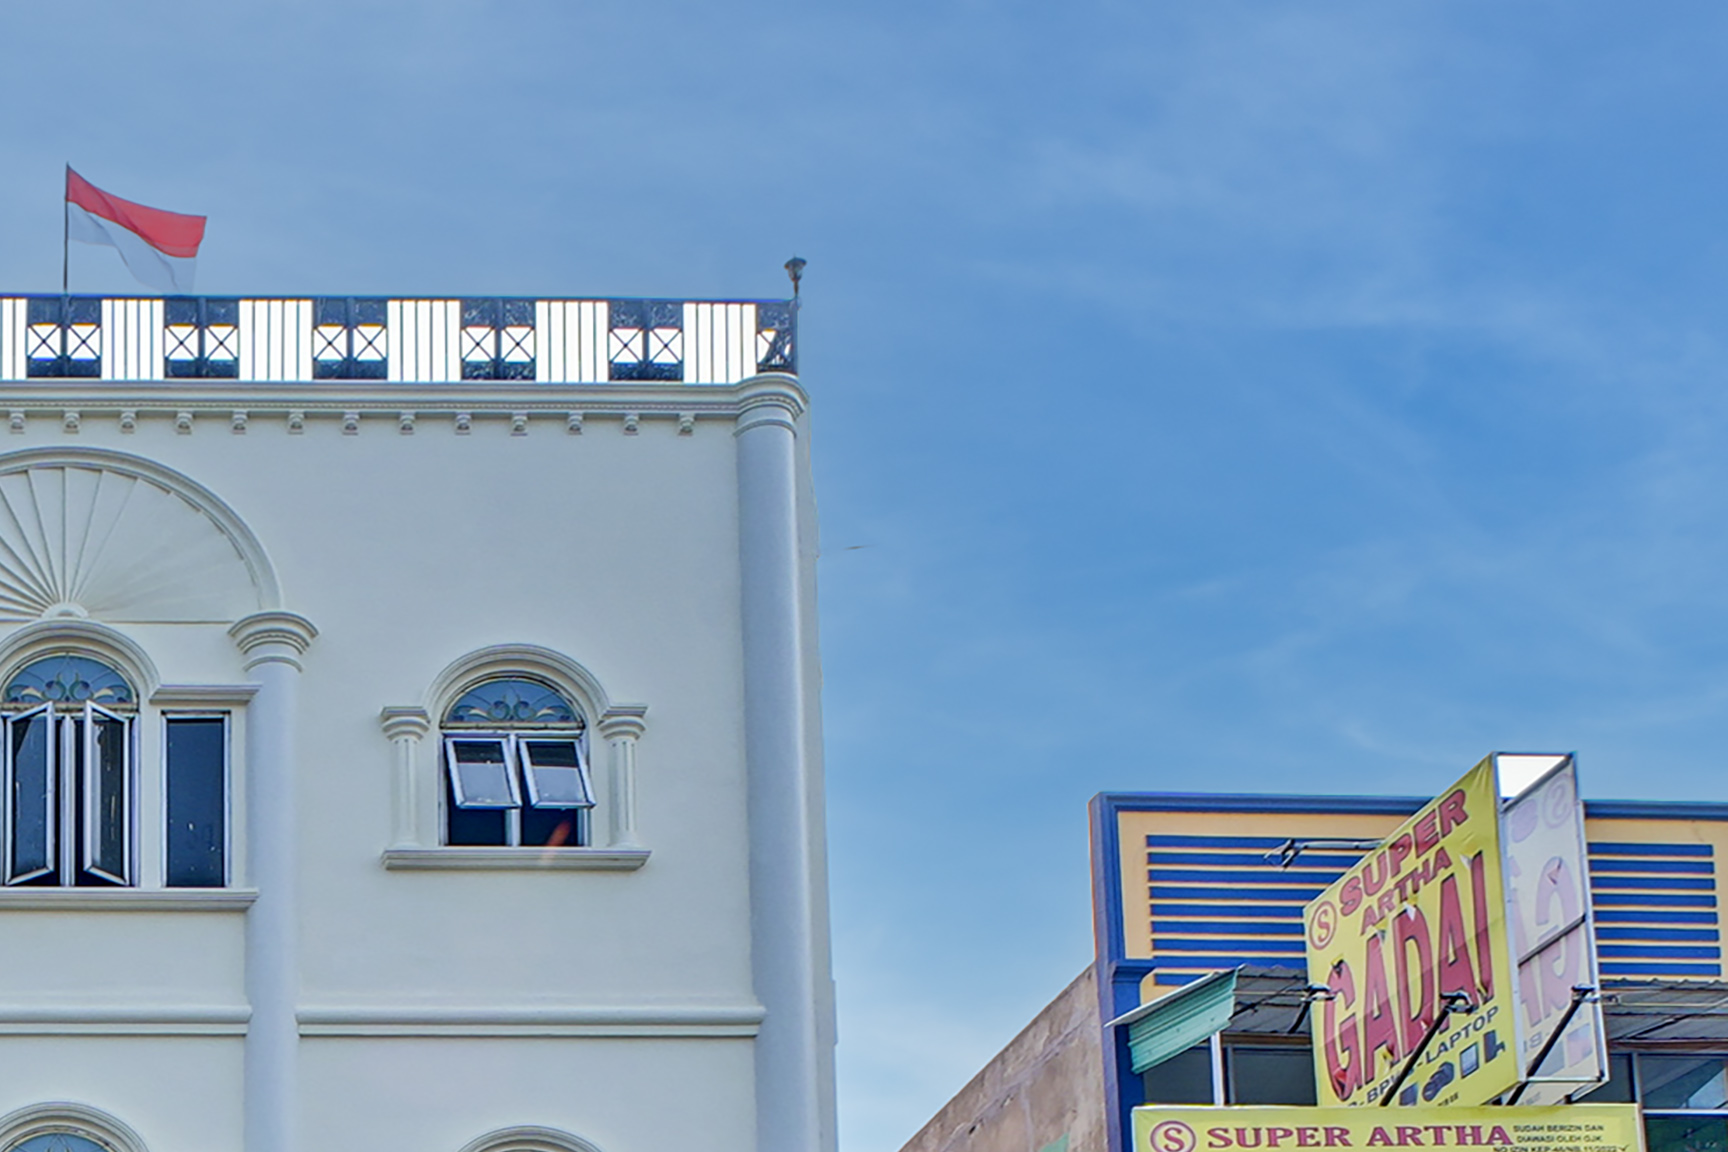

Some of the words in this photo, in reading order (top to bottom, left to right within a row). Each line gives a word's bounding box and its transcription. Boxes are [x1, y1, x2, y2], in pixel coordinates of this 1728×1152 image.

[1339, 788, 1469, 917] SUPER
[1360, 846, 1453, 936] ARTHA
[1325, 850, 1494, 1102] GADAI
[1207, 1126, 1354, 1149] SUPER
[1365, 1125, 1514, 1147] ARTHA
